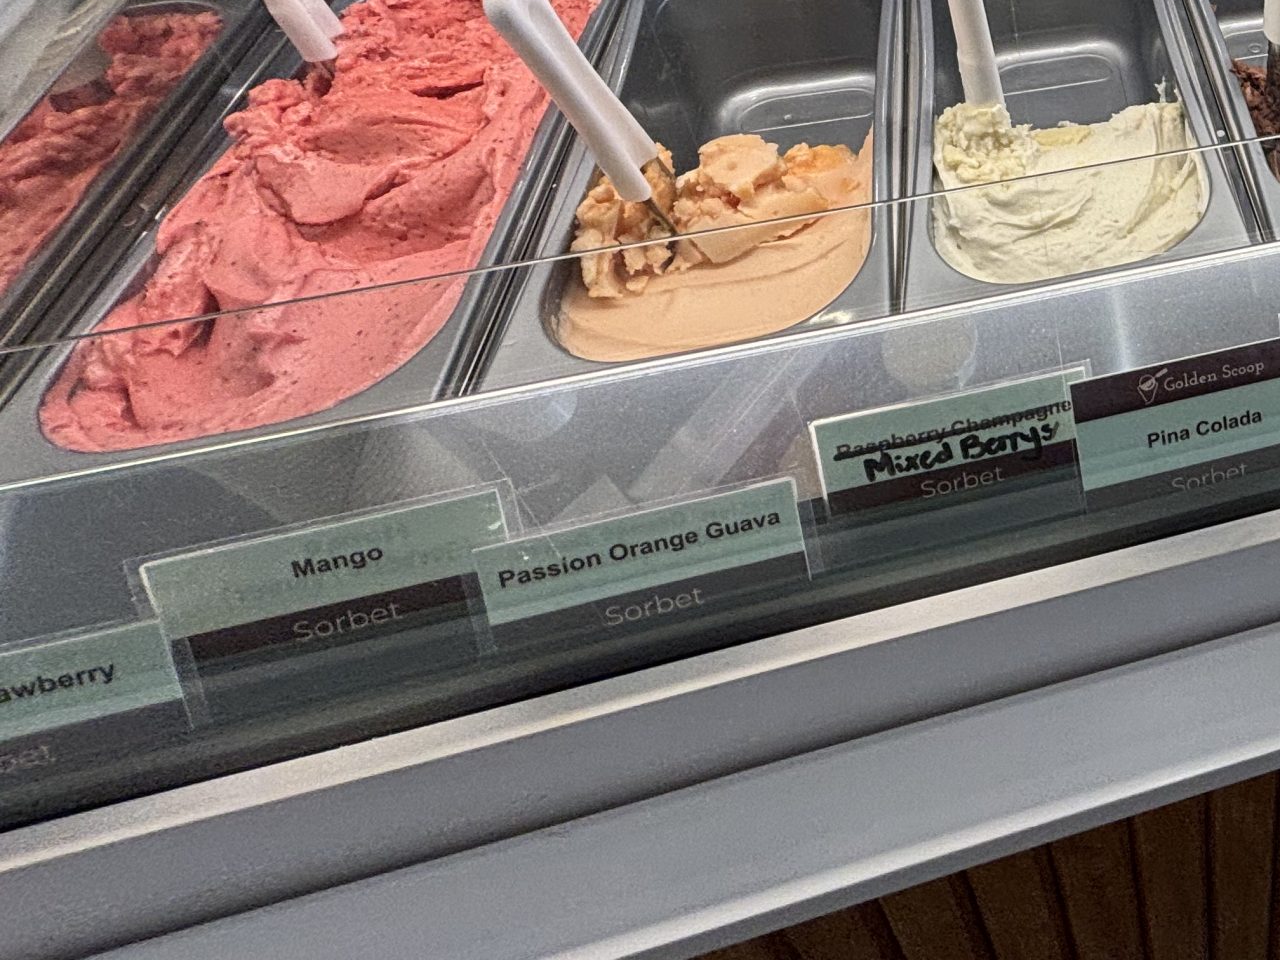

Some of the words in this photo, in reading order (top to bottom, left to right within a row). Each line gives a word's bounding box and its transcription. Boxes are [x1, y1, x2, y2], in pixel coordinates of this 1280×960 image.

[1163, 373, 1217, 392] Golden
[1222, 360, 1265, 378] Scoop
[1147, 427, 1190, 448] Pina
[1196, 410, 1262, 436] Colada
[863, 442, 954, 482] Mixed
[1171, 463, 1248, 489] Sorbet
[920, 466, 1005, 499] Sorbet
[291, 548, 383, 578] Mango
[498, 551, 602, 589] Passion
[608, 528, 699, 562] Orange
[705, 510, 780, 539] Guava
[293, 602, 403, 640] Sorbet
[604, 588, 705, 626] Sorbet
